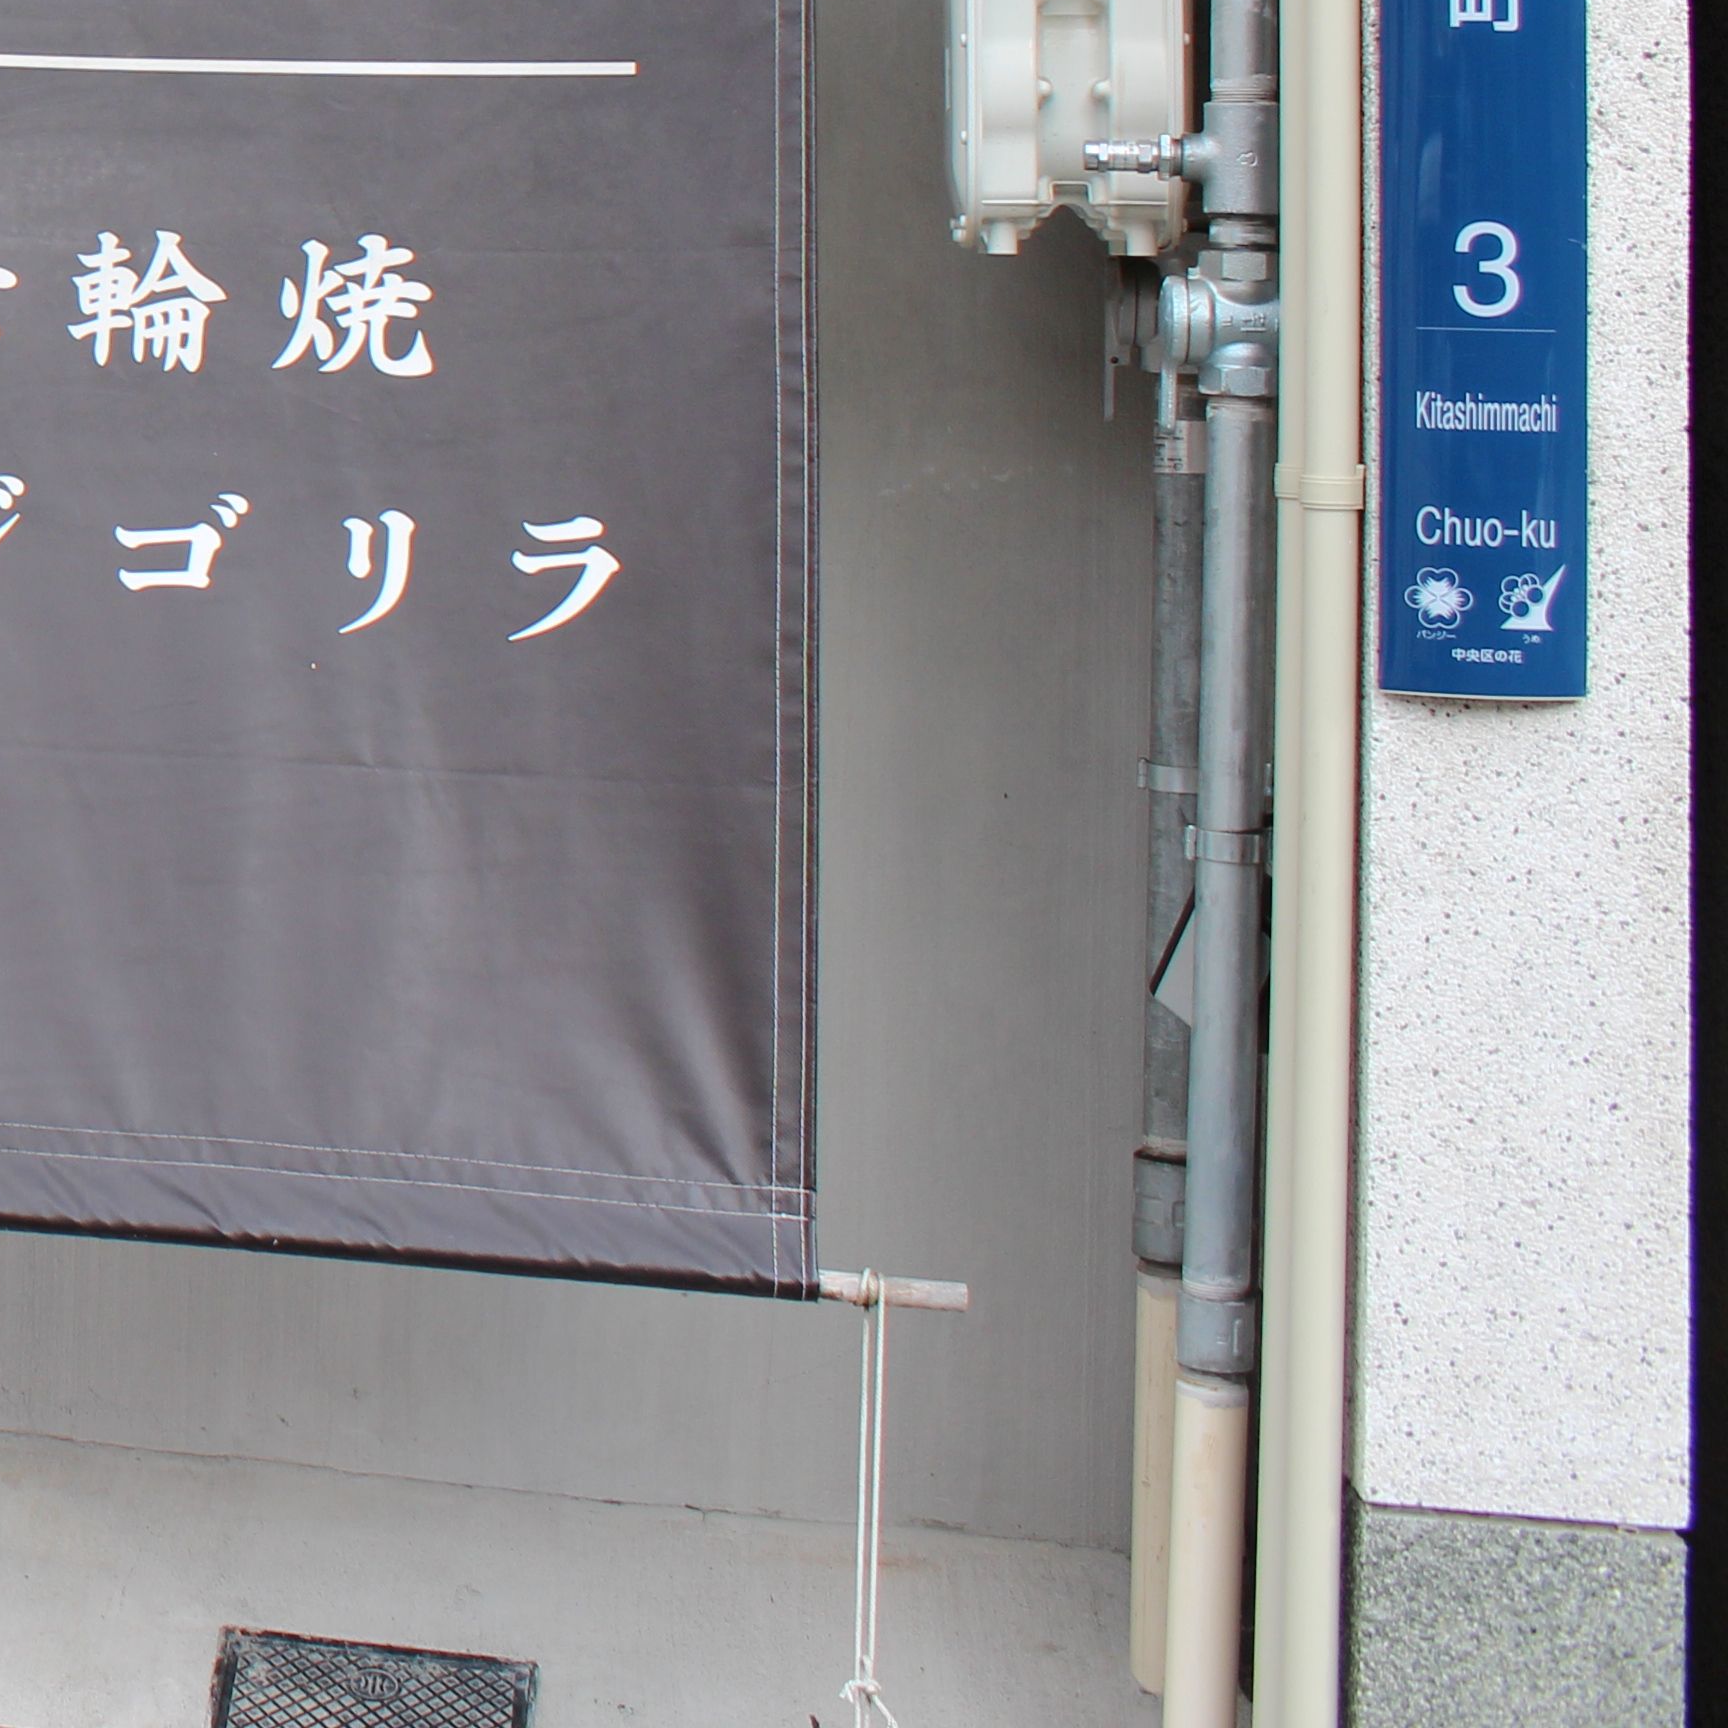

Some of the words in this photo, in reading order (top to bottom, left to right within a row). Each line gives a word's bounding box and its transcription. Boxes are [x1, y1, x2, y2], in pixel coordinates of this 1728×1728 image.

[1452, 219, 1522, 319] 3
[1415, 389, 1558, 434] Kitashimmachi
[1415, 504, 1557, 550] Chuo-ku
[1416, 630, 1456, 640] パンジー
[1521, 633, 1542, 645] うめ
[1451, 647, 1524, 664] 中央区の花
